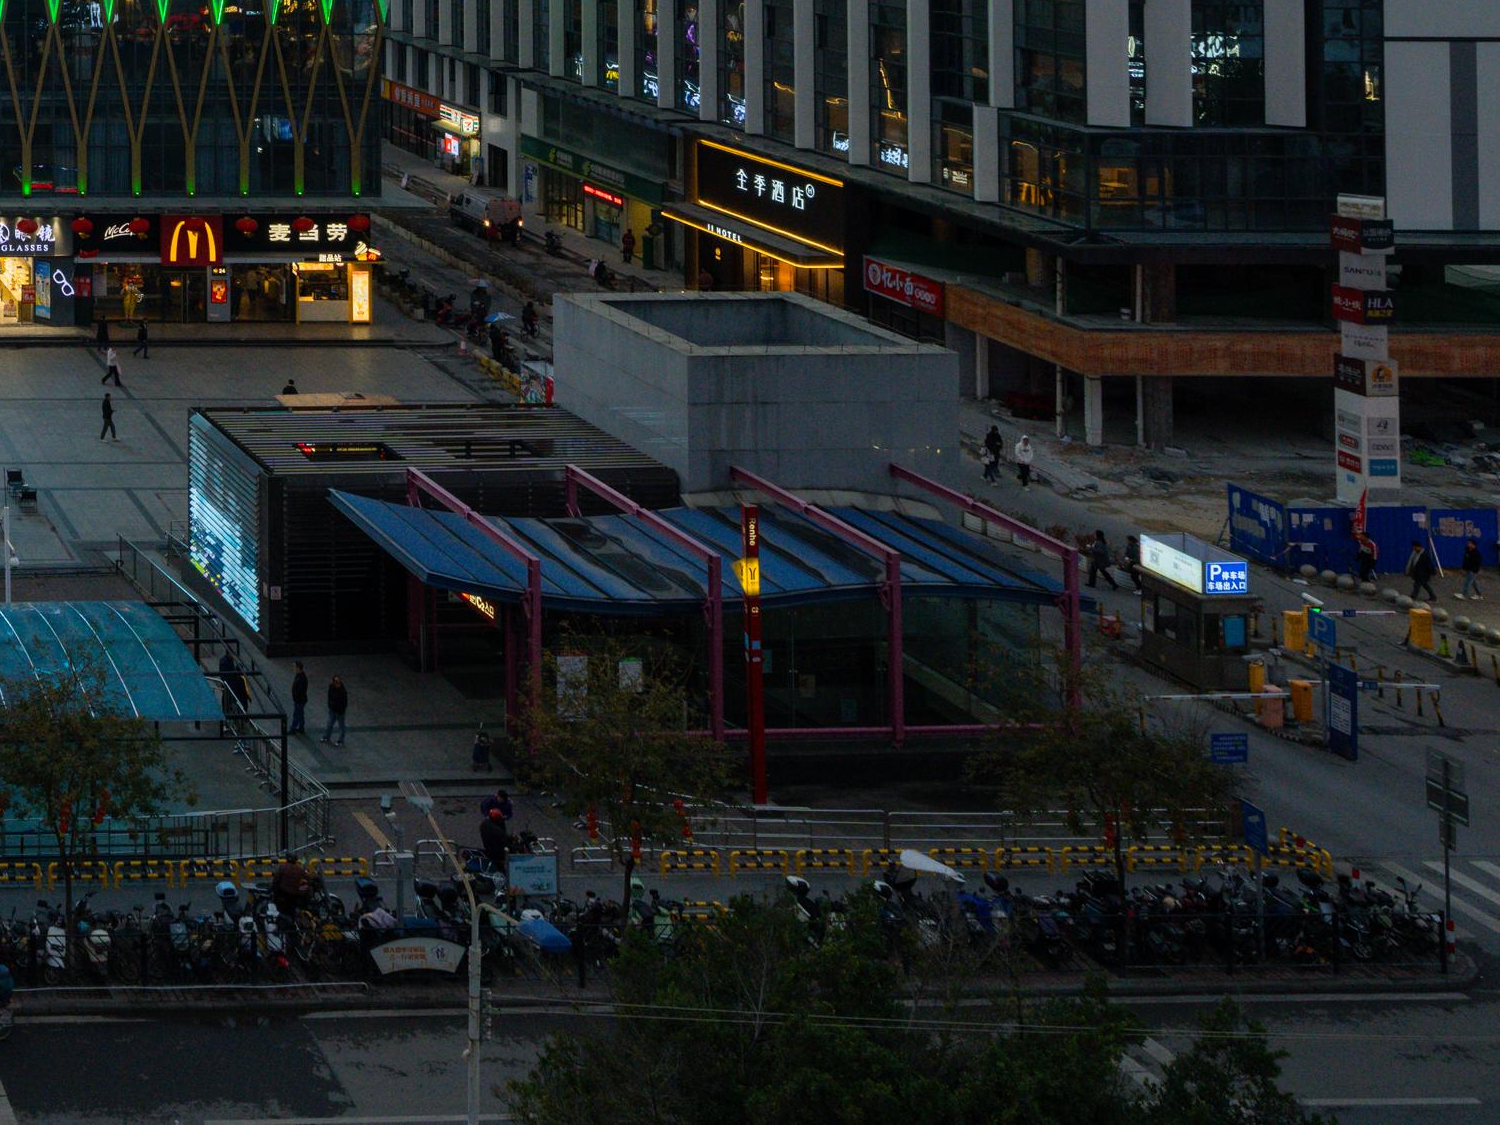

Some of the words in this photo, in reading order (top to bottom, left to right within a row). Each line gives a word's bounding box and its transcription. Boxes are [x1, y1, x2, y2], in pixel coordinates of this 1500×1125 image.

[736, 168, 805, 210] 全季酒店
[269, 223, 348, 242] 麦当劳
[716, 226, 742, 243] HOTEL
[1367, 298, 1393, 308] HLA
[1210, 564, 1221, 581] P
